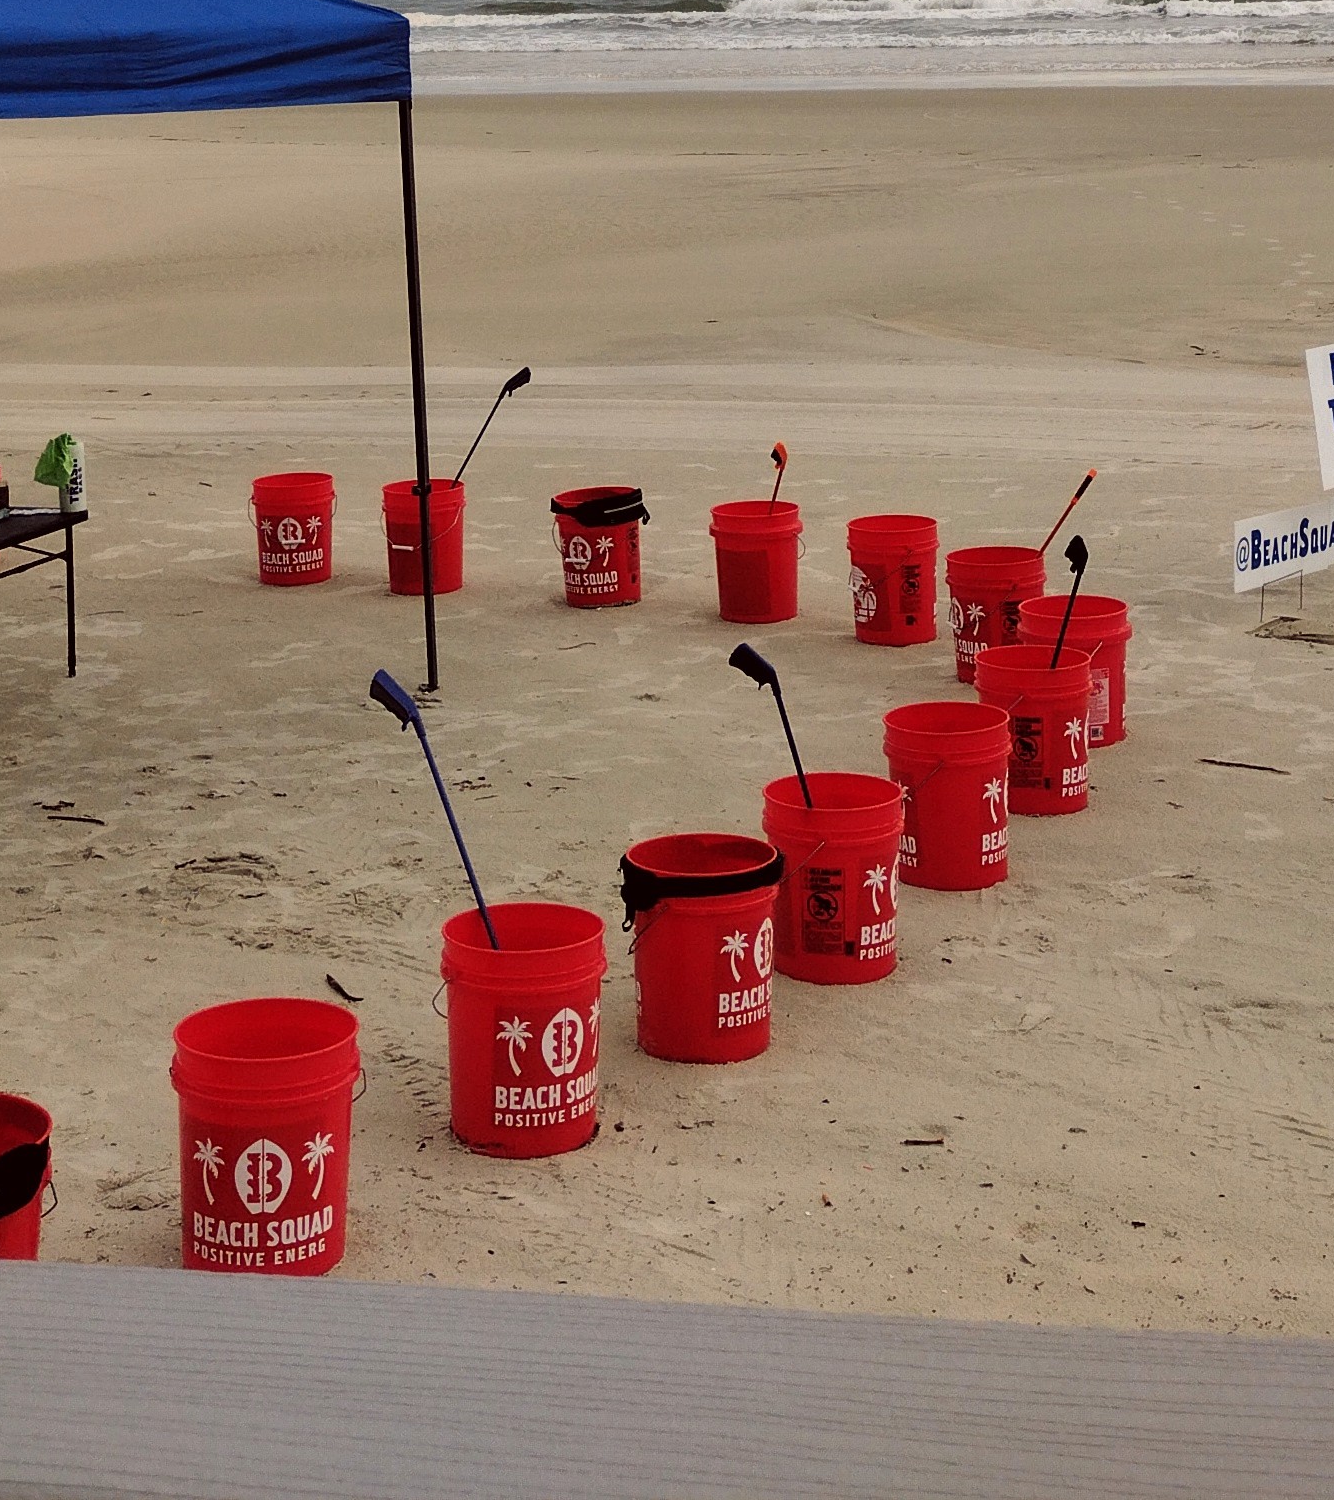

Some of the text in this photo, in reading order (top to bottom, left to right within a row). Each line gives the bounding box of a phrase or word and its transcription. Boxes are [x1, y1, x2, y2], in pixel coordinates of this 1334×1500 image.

[262, 548, 323, 565] BEACH SQUAD
[263, 560, 323, 573] POSITIVE ENERGY
[583, 571, 618, 586] SQUAD
[587, 584, 618, 595] ENERGY
[958, 639, 988, 655] SQUAD
[1062, 763, 1088, 785] BEAC
[982, 826, 1008, 852] BEAC
[719, 983, 765, 1014] BEACH
[718, 1005, 766, 1029] POSITIVE
[495, 1084, 561, 1110] BEACH
[494, 1110, 565, 1128] POSITIVE
[193, 1205, 333, 1247] BEACH SQUAD
[193, 1238, 326, 1267] POSITIVE ENERG
